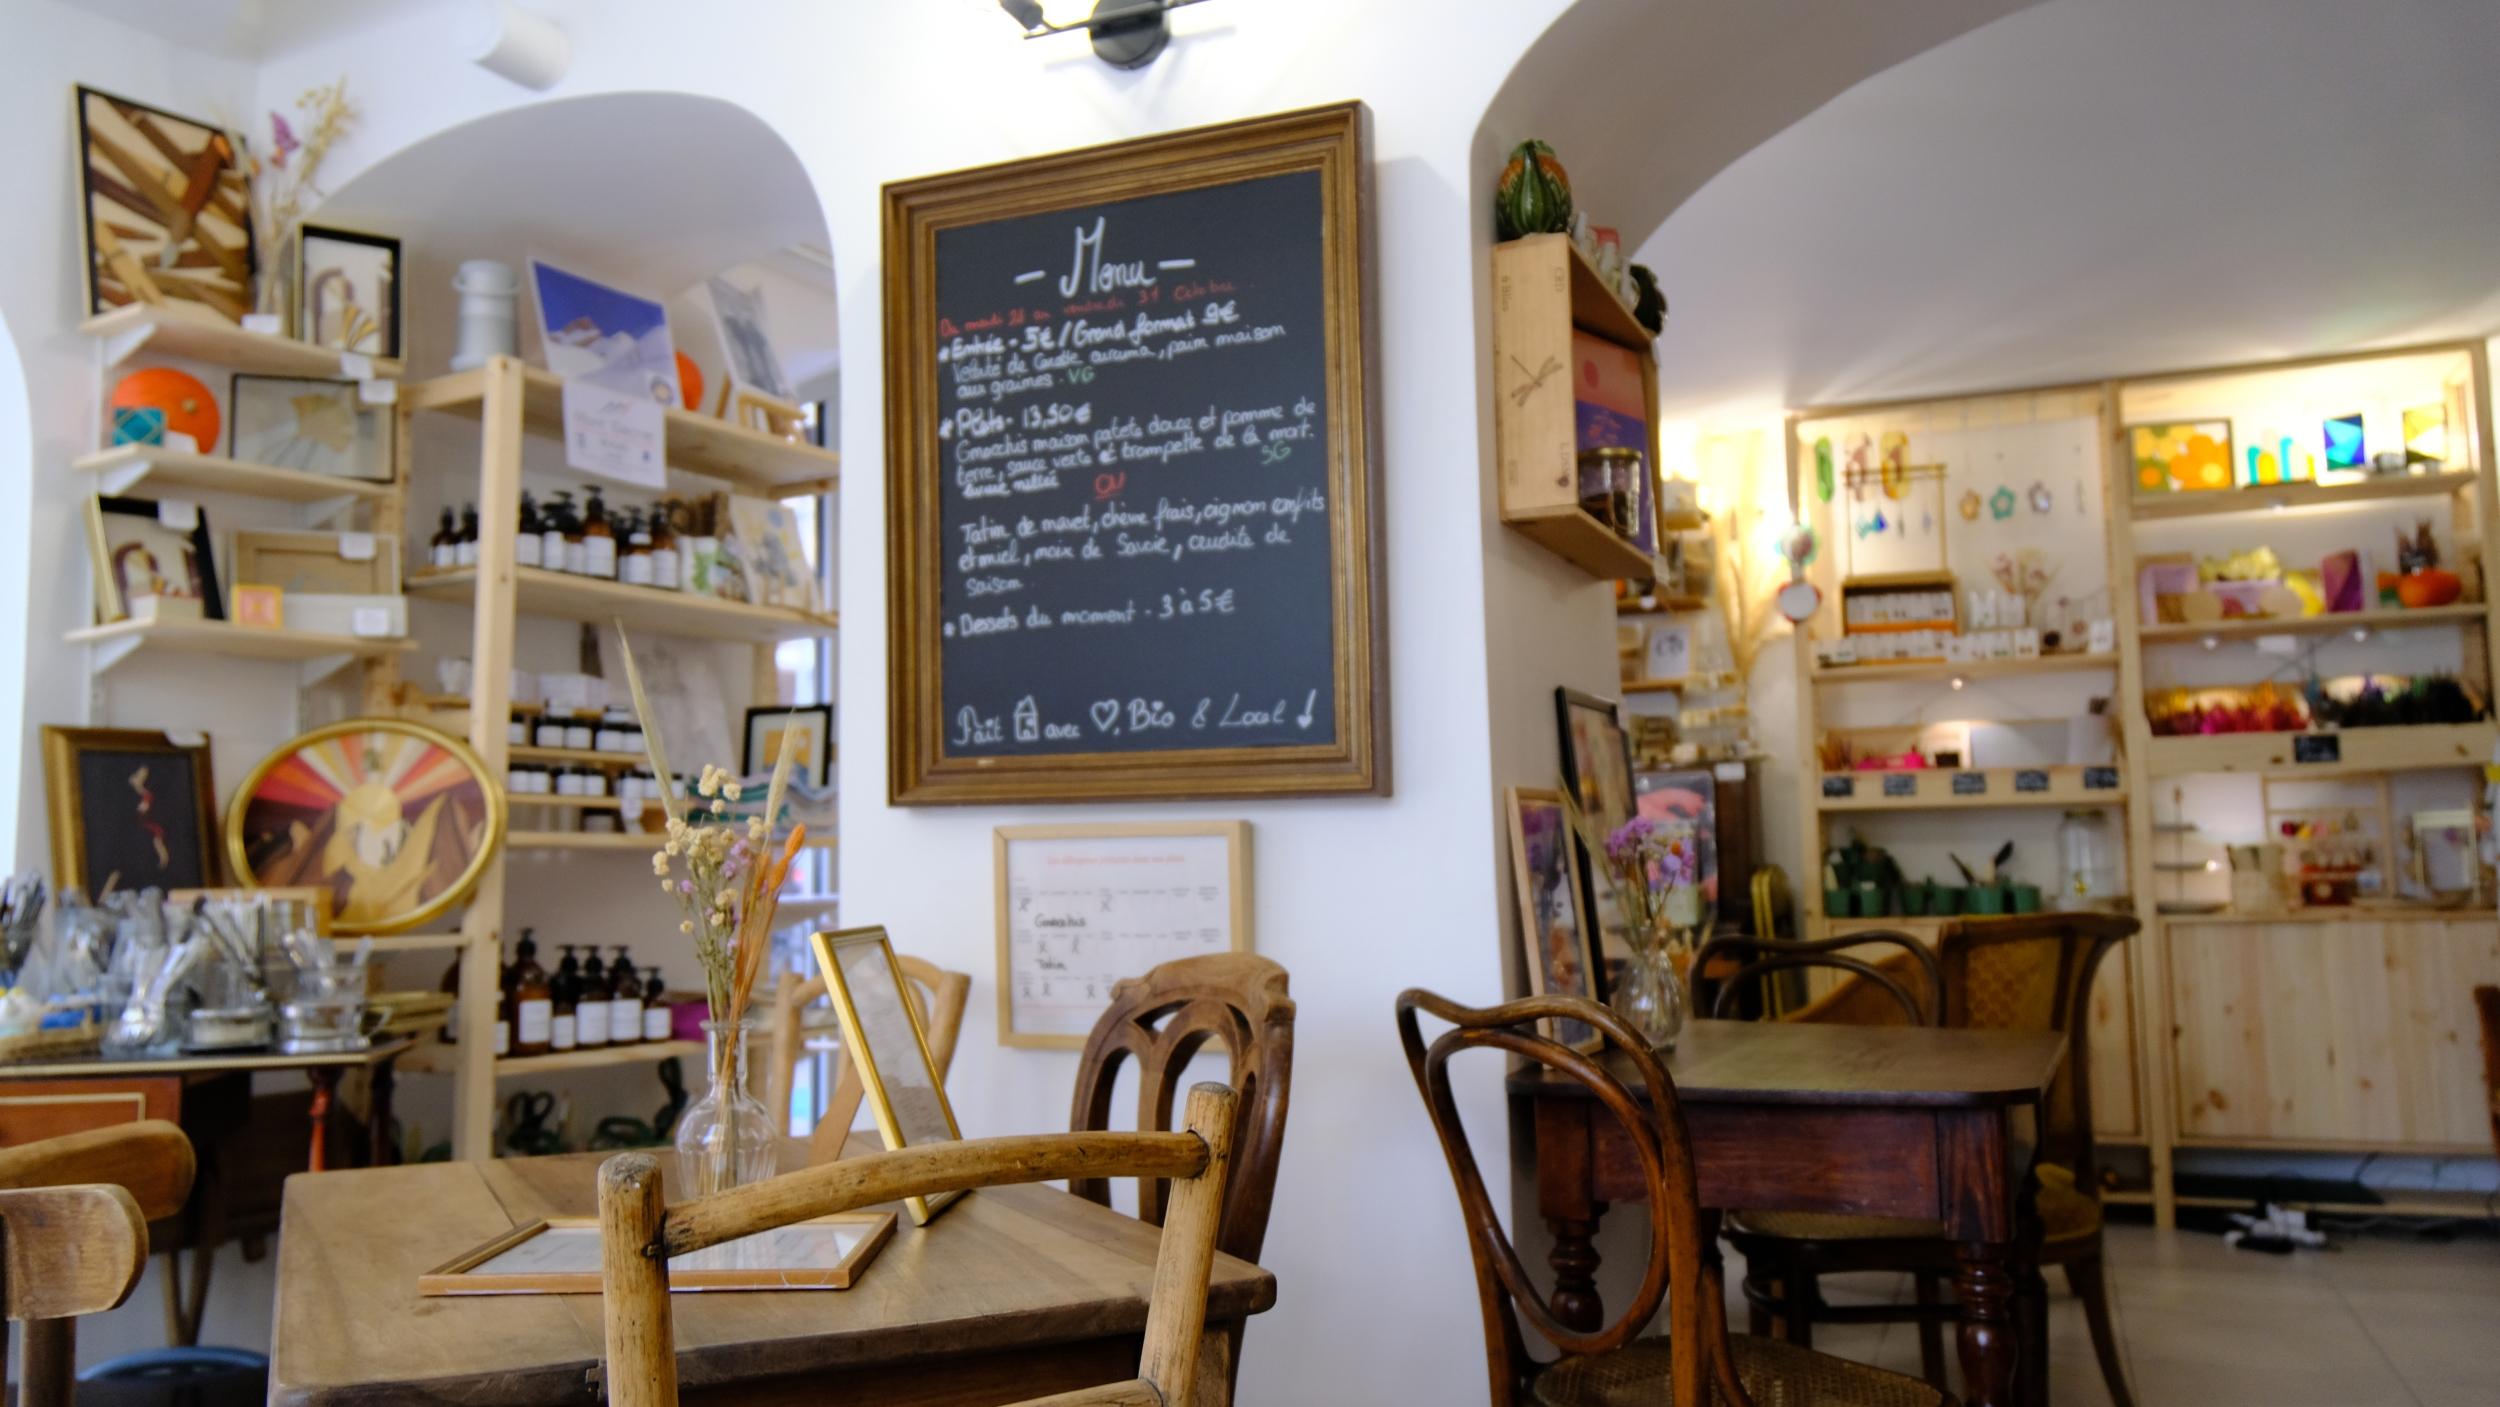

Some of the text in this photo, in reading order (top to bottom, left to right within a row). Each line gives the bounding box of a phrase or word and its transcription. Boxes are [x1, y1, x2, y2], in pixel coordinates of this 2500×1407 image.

[1059, 216, 1156, 297] Menu
[1128, 310, 1196, 346] format
[1202, 300, 1240, 325] 9€
[1216, 324, 1287, 347] maison
[1033, 430, 1090, 452] maison
[1220, 404, 1284, 436] pomme
[1294, 396, 1317, 416] de
[1264, 522, 1292, 544] de
[1061, 600, 1136, 624] moment
[1159, 594, 1174, 618] 3
[1044, 723, 1082, 740] avec
[1128, 698, 1176, 731] Bio
